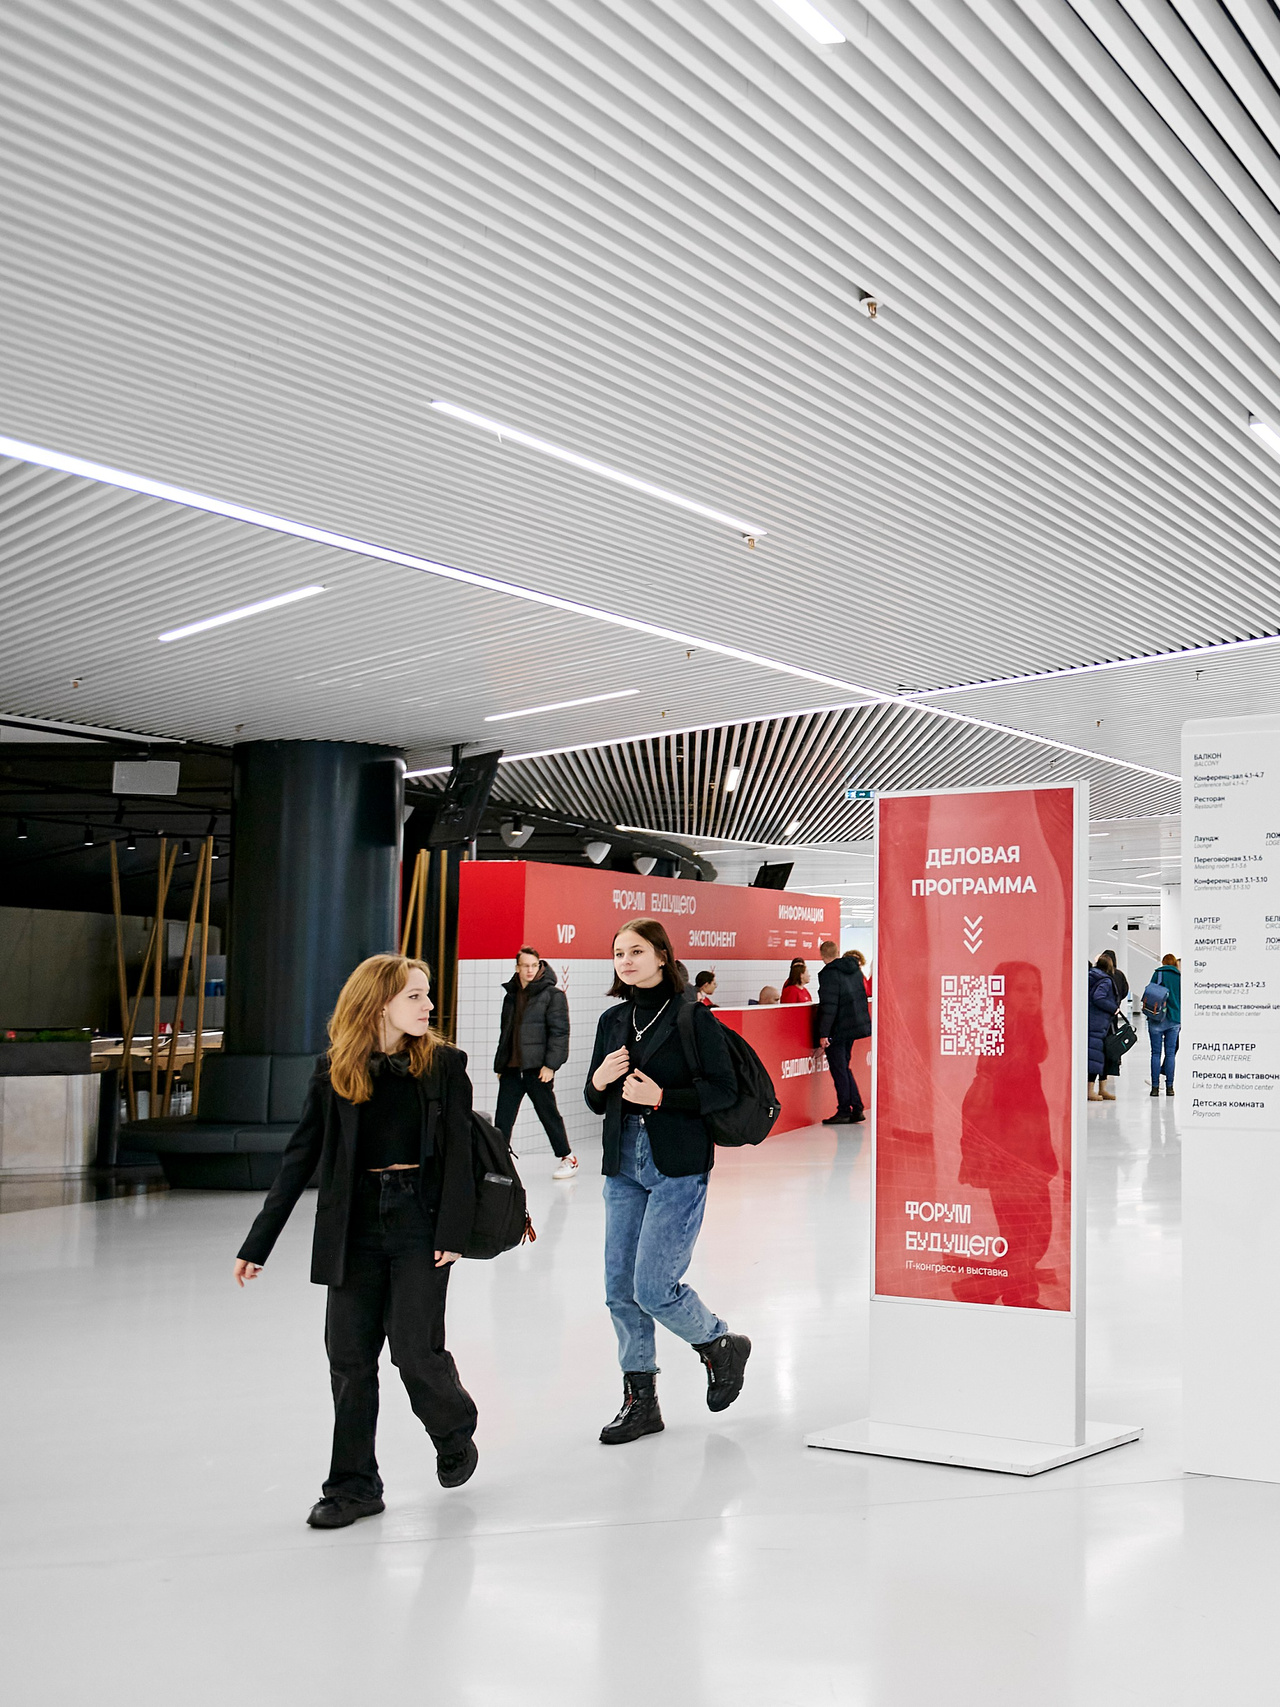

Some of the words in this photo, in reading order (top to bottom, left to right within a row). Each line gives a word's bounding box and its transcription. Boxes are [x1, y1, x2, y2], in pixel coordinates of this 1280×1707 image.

[1194, 835, 1219, 843] Лаундж
[925, 845, 1020, 869] ДЕЛОВАЯ
[911, 875, 1037, 897] ПРОГРАММА
[613, 889, 646, 911] ФОРУМ
[778, 904, 824, 924] ИНФОРМАЦИЯ
[557, 923, 576, 944] VIP
[688, 929, 737, 947] ЭКСПОНЕНТ
[1192, 1042, 1221, 1051] ГРАНД
[1222, 1043, 1256, 1051] ПАРТЕР
[1192, 1070, 1227, 1080] Переход
[1192, 1098, 1227, 1108] Детская
[1192, 1110, 1221, 1118] Playroom
[905, 1201, 971, 1224] ФОРУМ
[905, 1260, 957, 1274] IT-конгресс
[958, 1265, 964, 1273] и
[966, 1266, 1009, 1277] выставка
